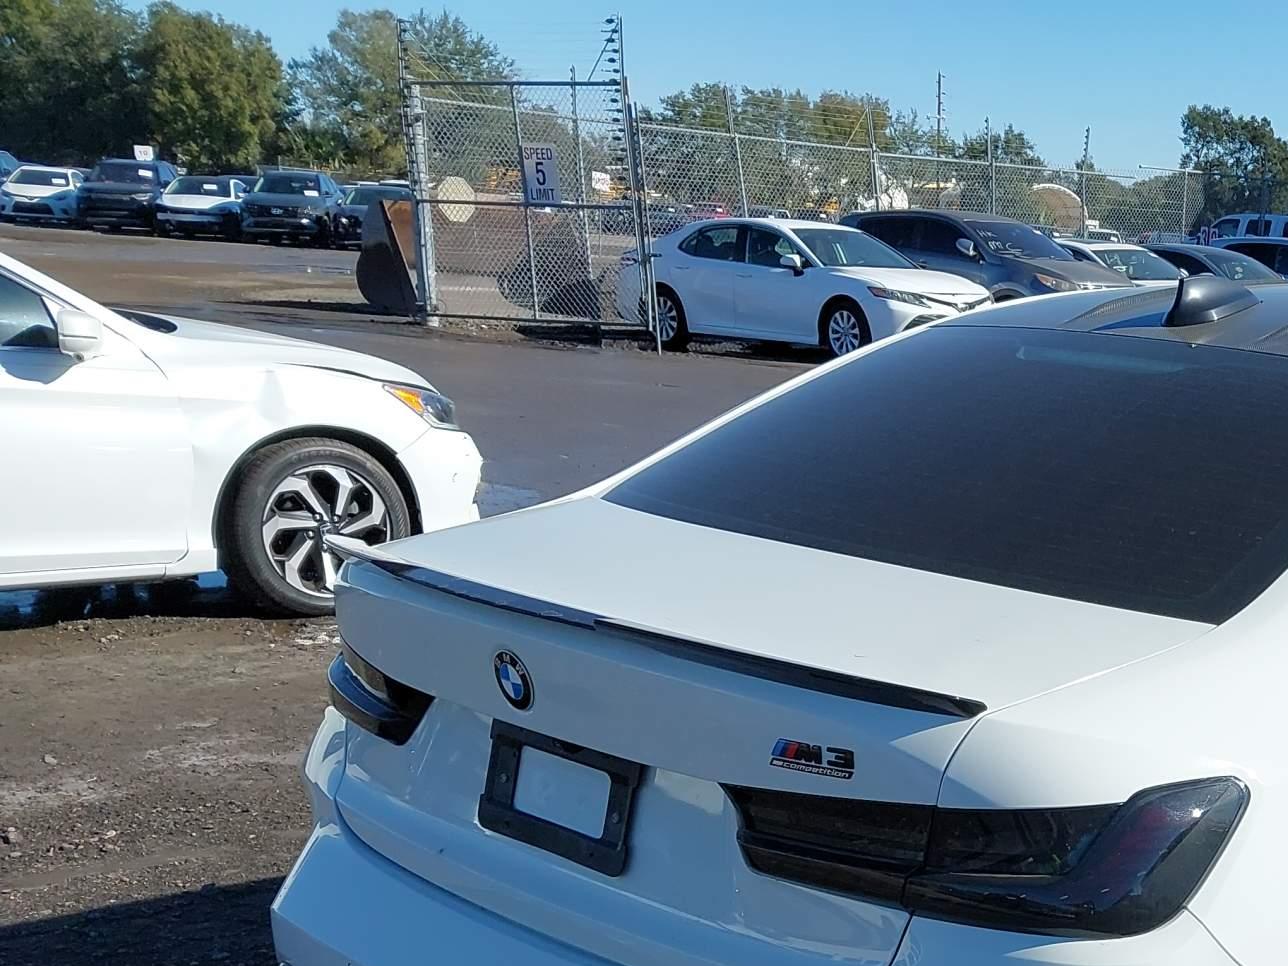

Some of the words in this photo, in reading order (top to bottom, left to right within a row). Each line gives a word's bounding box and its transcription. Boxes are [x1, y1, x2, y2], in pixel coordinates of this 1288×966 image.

[523, 147, 553, 160] SPEED
[535, 161, 547, 186] 5
[530, 187, 555, 201] LIMIT
[494, 652, 525, 676] BMW
[794, 740, 855, 770] M3
